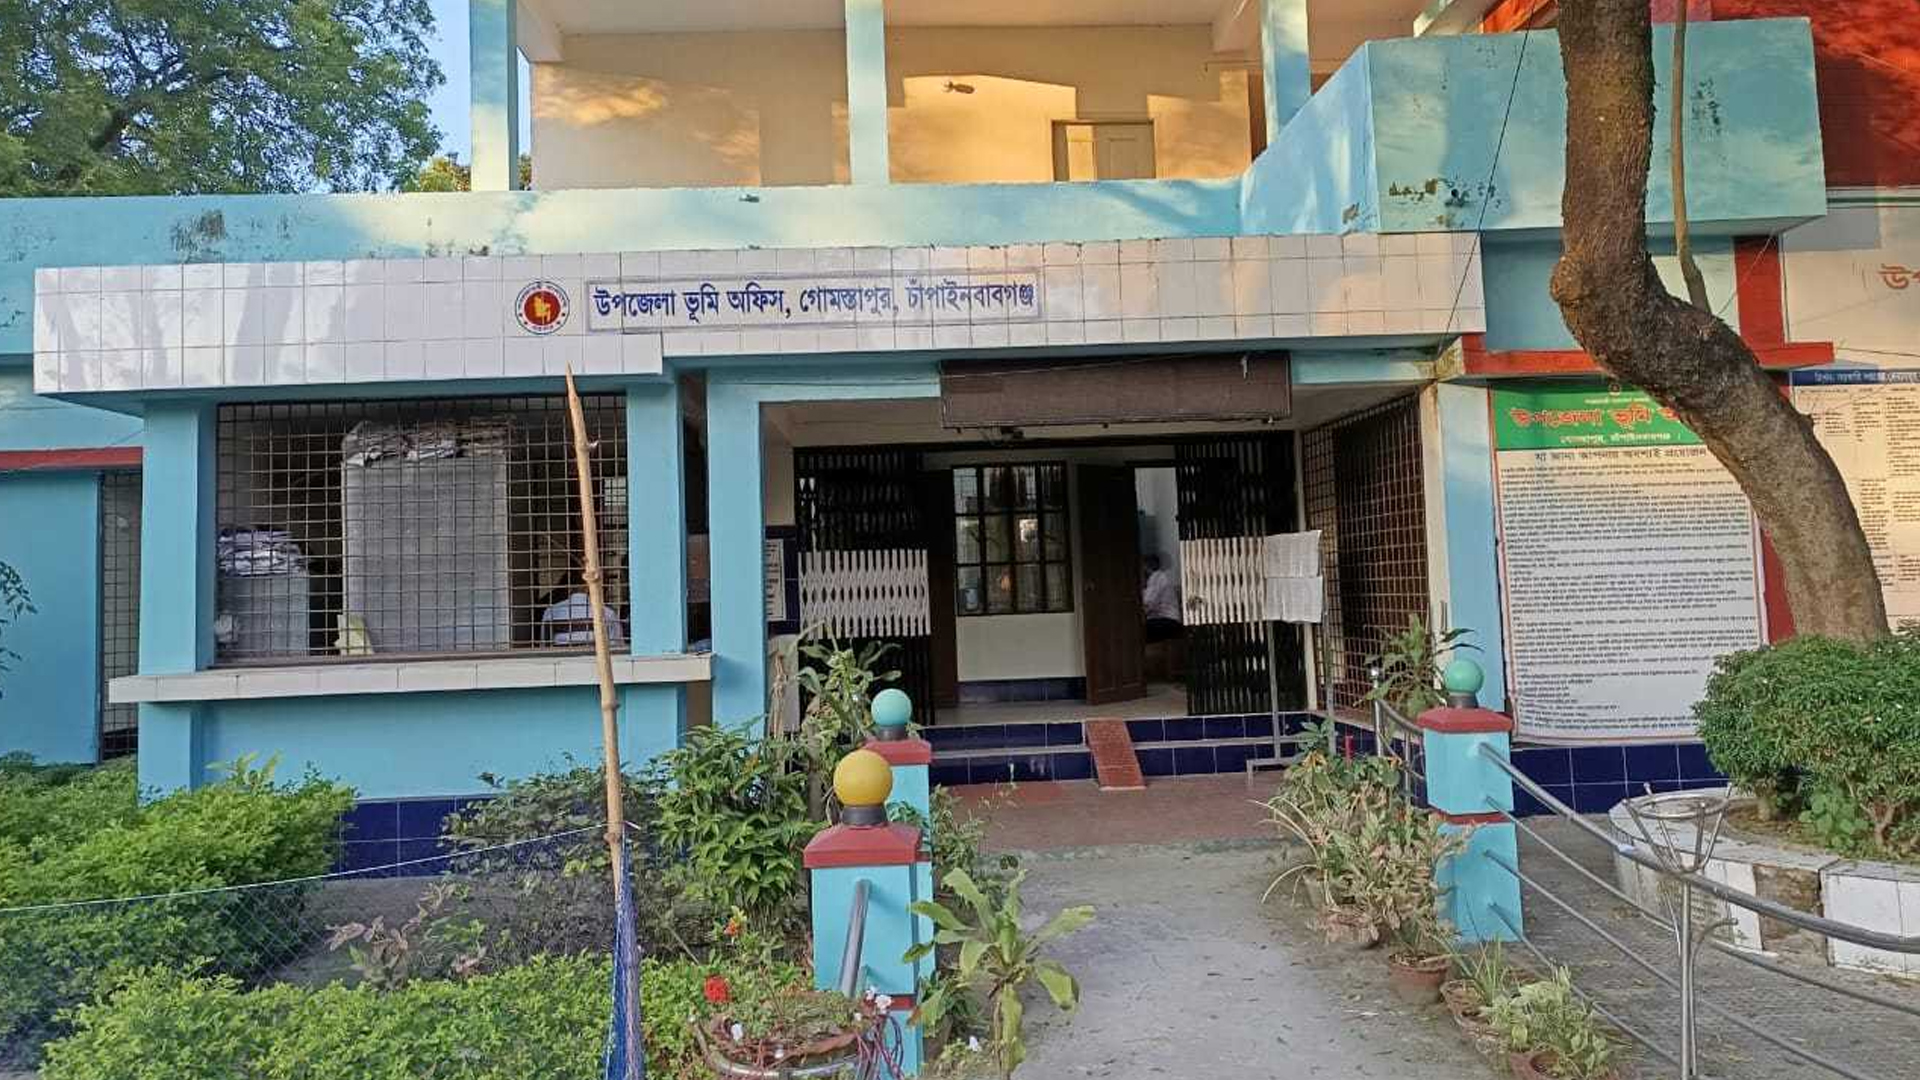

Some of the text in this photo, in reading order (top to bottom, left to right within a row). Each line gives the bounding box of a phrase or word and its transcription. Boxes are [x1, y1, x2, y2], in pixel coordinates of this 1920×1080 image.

[593, 287, 676, 317] উপজেলা
[682, 282, 719, 324] ভূমি
[726, 281, 792, 319] অফিস,
[799, 283, 899, 319] গোমস্তাপুর,
[905, 278, 1035, 312] চাঁপাইনবাবগঞ্জ
